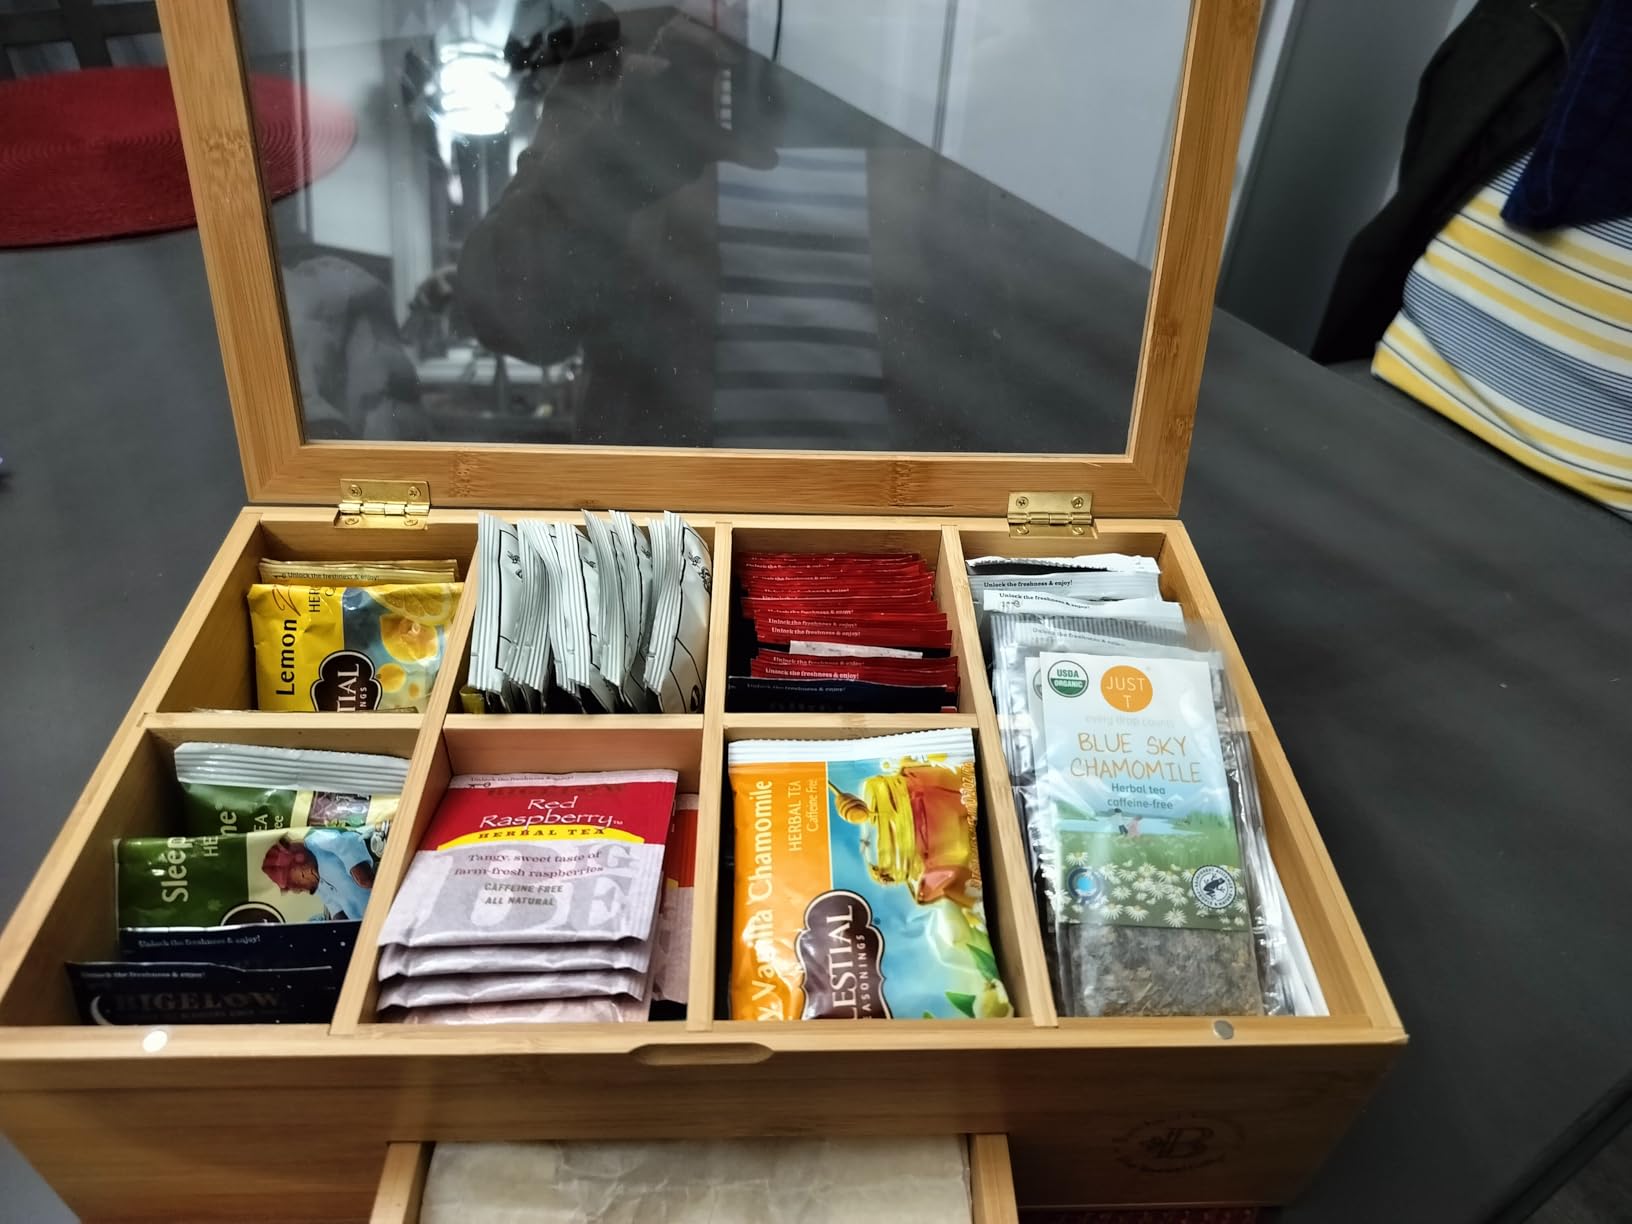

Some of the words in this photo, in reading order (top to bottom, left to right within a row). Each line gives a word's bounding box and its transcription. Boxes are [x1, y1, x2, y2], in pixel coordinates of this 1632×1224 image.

[1034, 595, 1065, 604] freshness
[276, 618, 299, 696] Lemon
[801, 670, 832, 678] freshness
[1056, 668, 1080, 679] USDA
[1054, 680, 1084, 688] ORGANIC
[1106, 676, 1146, 692] JUST
[1122, 694, 1132, 709] T
[1078, 732, 1134, 754] BLUE
[1146, 735, 1187, 757] SKY
[1070, 757, 1202, 783] CHAMOMILE
[788, 780, 802, 797] TEA
[1111, 782, 1147, 794] Herbal
[1148, 785, 1166, 795] tea
[527, 795, 580, 810] Red
[1107, 798, 1174, 810] caffeine-free
[806, 794, 820, 832] Caffeine
[788, 800, 804, 852] HERBAL
[478, 829, 558, 839] HERBAL
[567, 828, 606, 836] TEA
[747, 780, 774, 902] Chamomile
[514, 854, 552, 863] sweet
[554, 853, 585, 864] taste
[587, 850, 602, 860] of
[161, 836, 193, 902] Sleep
[454, 868, 526, 877] farm-fresh
[529, 866, 604, 880] raspberries
[484, 882, 535, 894] CAFFEINE
[537, 884, 565, 894] FREE
[485, 896, 504, 906] ALL
[508, 896, 556, 906] NATURAL
